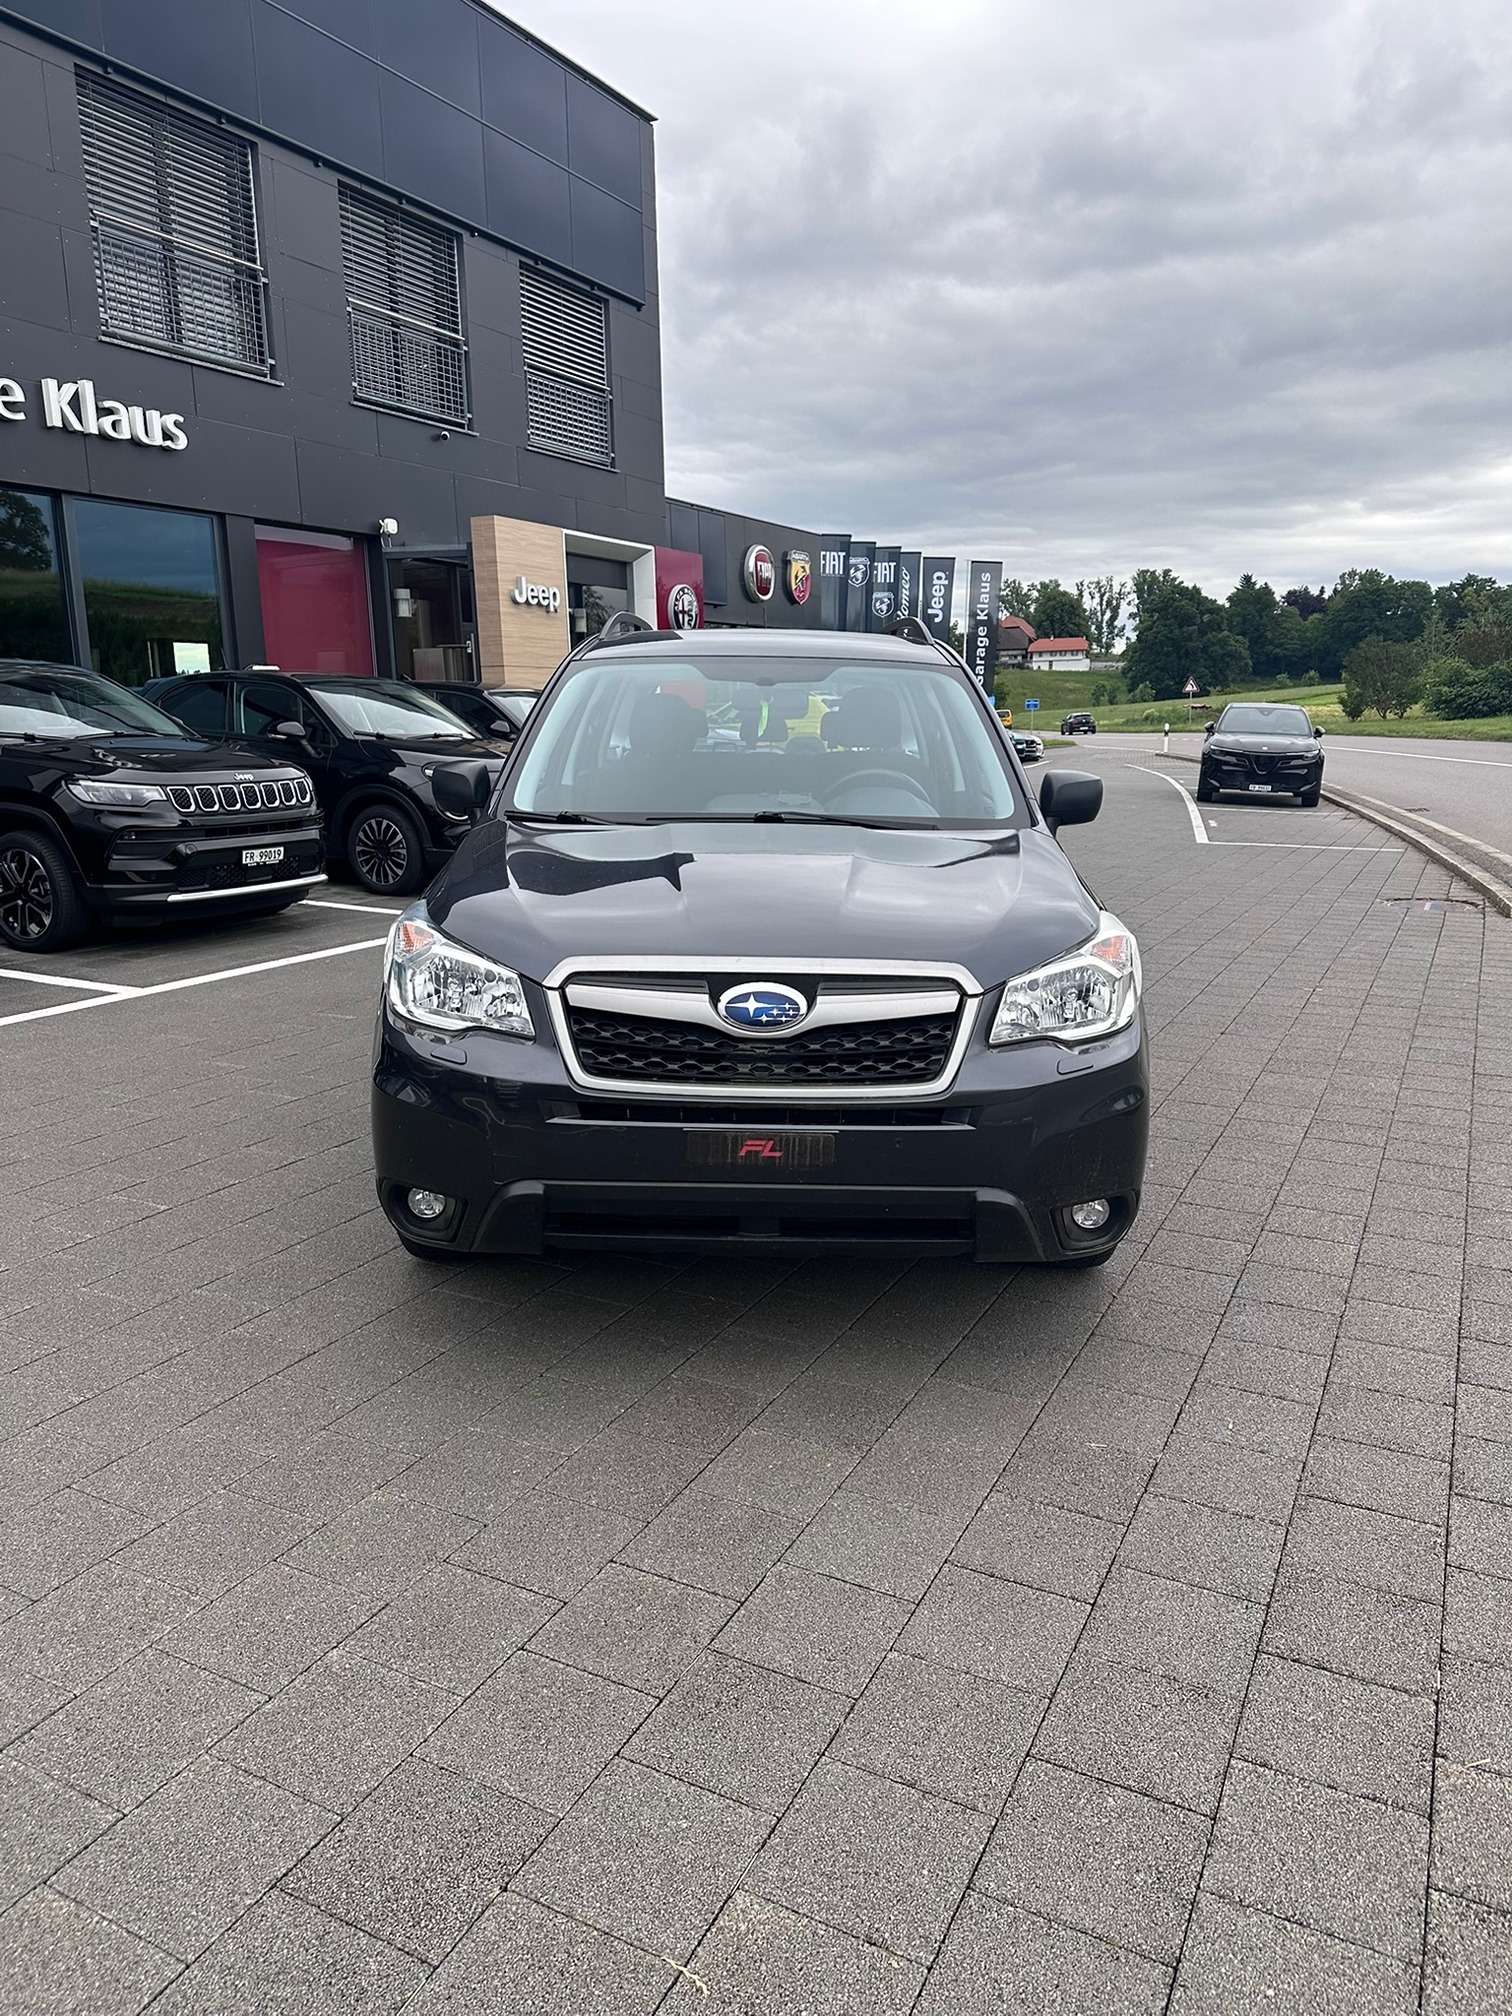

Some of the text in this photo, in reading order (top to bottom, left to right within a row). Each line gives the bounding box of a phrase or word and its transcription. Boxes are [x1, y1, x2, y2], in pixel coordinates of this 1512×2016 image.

[41, 378, 188, 450] Klaus
[820, 551, 846, 574] FIAT
[512, 575, 561, 612] Jeep
[928, 571, 947, 622] Jeep
[976, 572, 991, 620] Klaus
[244, 848, 282, 863] FR 99019
[738, 1139, 784, 1157] FL
